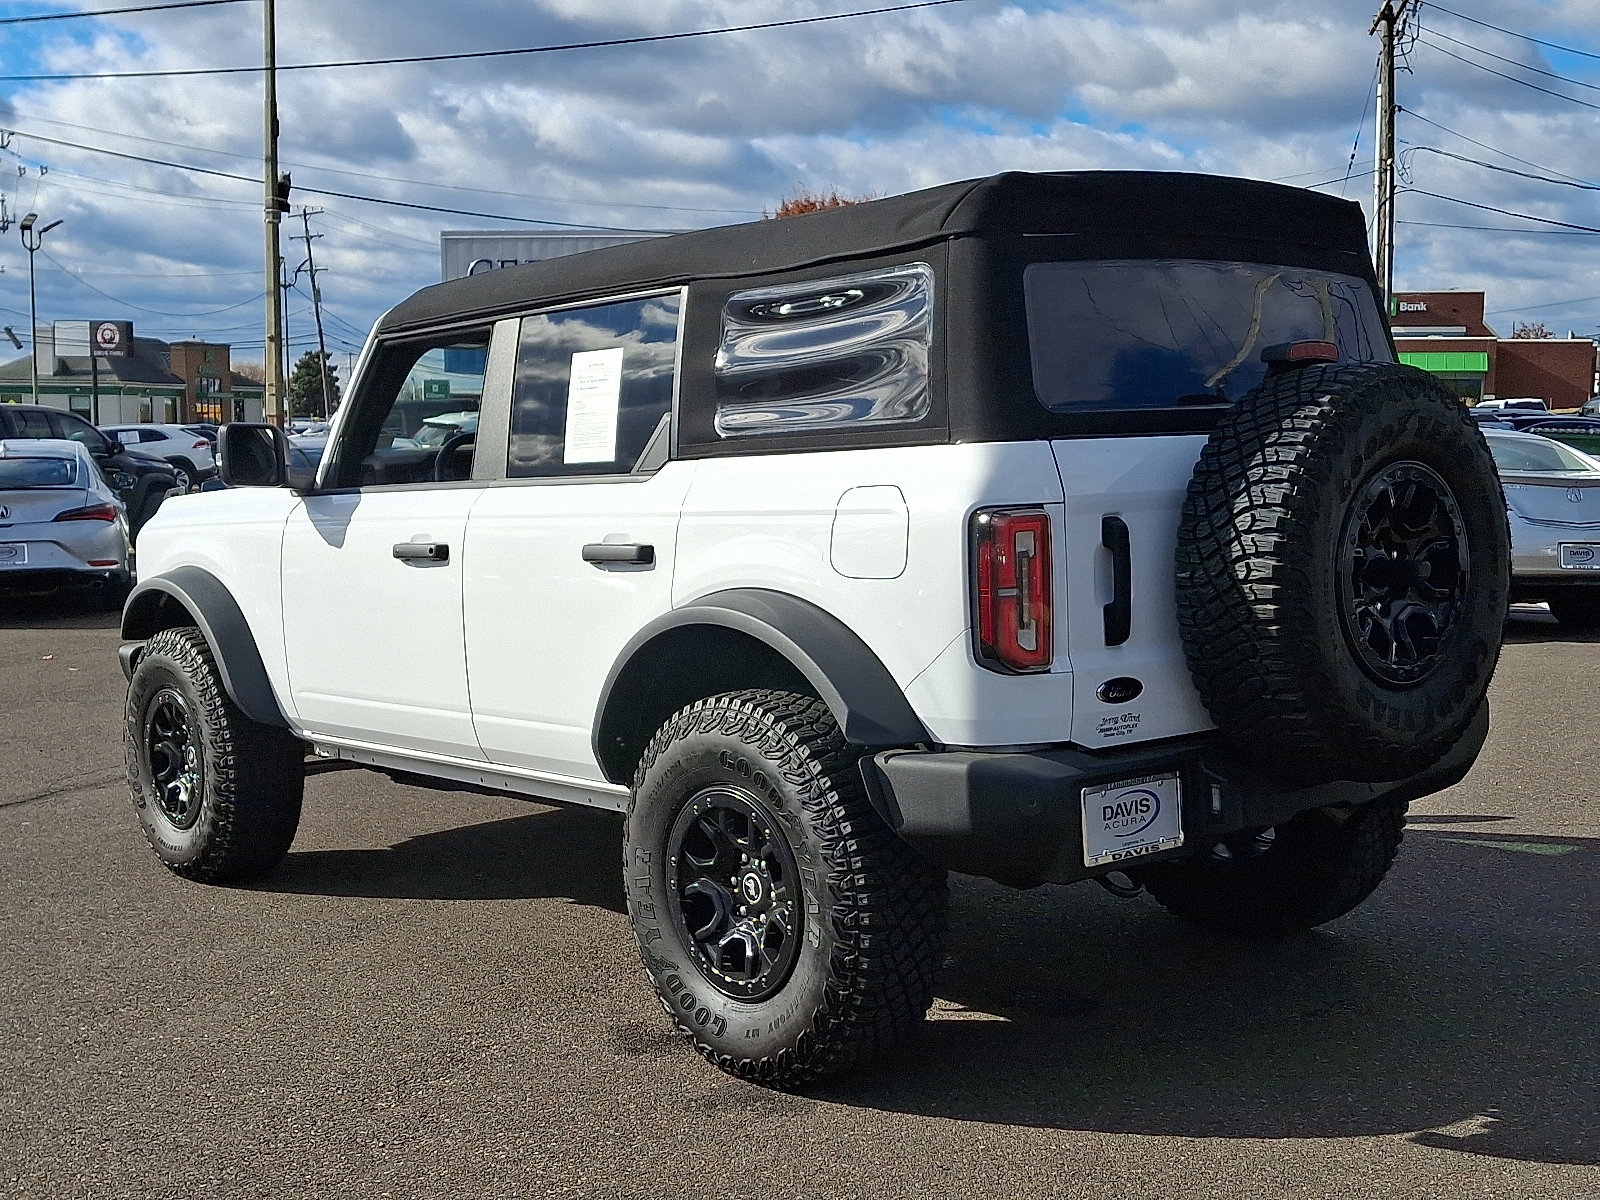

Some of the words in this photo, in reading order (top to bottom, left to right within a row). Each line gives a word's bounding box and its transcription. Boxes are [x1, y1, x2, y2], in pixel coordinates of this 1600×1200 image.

[1399, 301, 1428, 312] Bank
[1102, 797, 1151, 822] DAVIS
[1103, 815, 1147, 831] ACURA
[1111, 844, 1161, 861] DAVIS
[744, 1028, 760, 1039] MT
